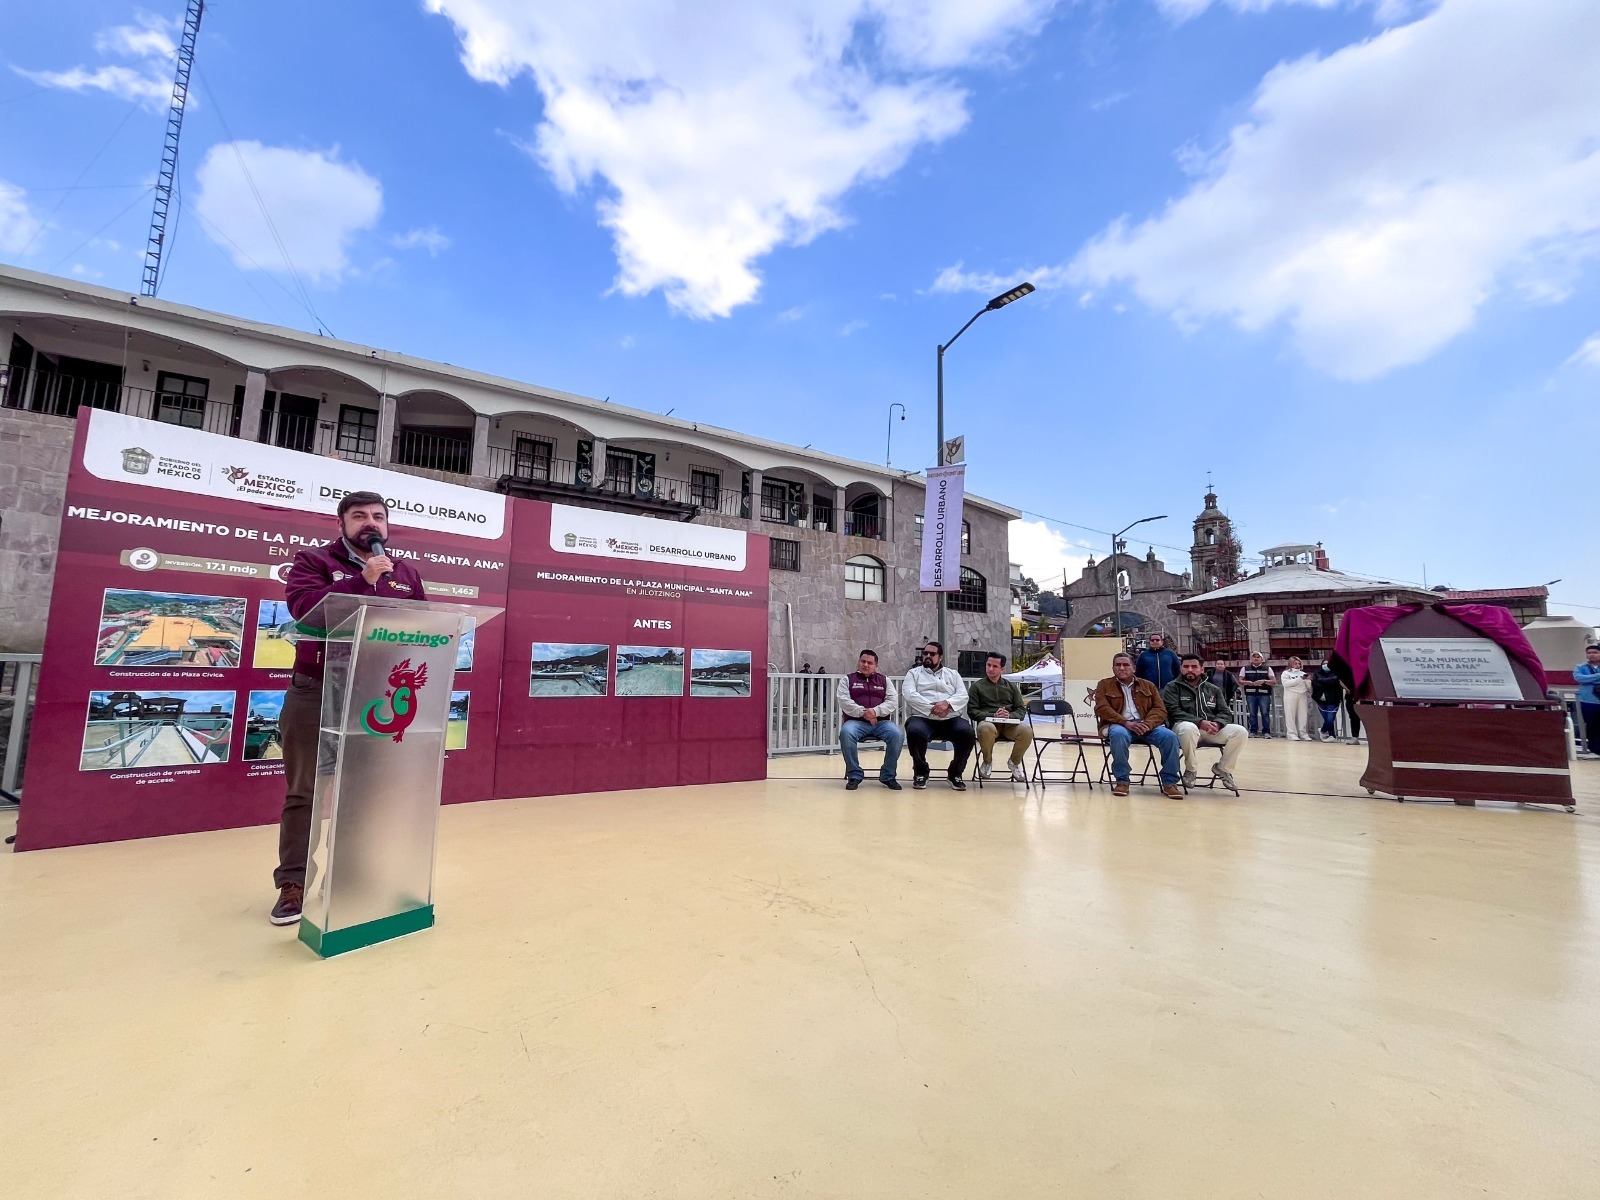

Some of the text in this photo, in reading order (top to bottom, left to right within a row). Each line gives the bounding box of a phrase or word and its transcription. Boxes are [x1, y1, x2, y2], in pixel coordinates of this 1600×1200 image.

[158, 461, 190, 472] ESTADO
[157, 466, 201, 480] MÉXICO
[257, 474, 285, 484] ESTADO
[246, 488, 265, 497] poder
[936, 479, 947, 521] URBANO
[429, 505, 487, 524] URBANO
[67, 505, 230, 537] MEJORAMIENTO
[234, 527, 259, 541] DE
[262, 531, 285, 544] LA
[289, 535, 336, 548] PLAZ
[268, 546, 290, 557] EN
[649, 544, 703, 558] DESARROLLO
[704, 552, 737, 562] URBANO
[934, 521, 944, 587] DESARROLLO
[205, 562, 226, 571] 17.1
[229, 565, 258, 575] mdp
[536, 571, 608, 585] MEJORAMIENTO
[609, 578, 622, 586] DE
[623, 579, 635, 587] LA
[636, 580, 663, 589] PLAZA
[664, 582, 705, 593] MUNICIPAL
[451, 587, 474, 596] 1,462
[638, 589, 681, 599] JILOTZINGO
[633, 618, 672, 630] ANTES
[366, 627, 450, 648] Jilotzingo
[1437, 656, 1490, 664] MUNICIPAL
[110, 770, 161, 780] Construcción
